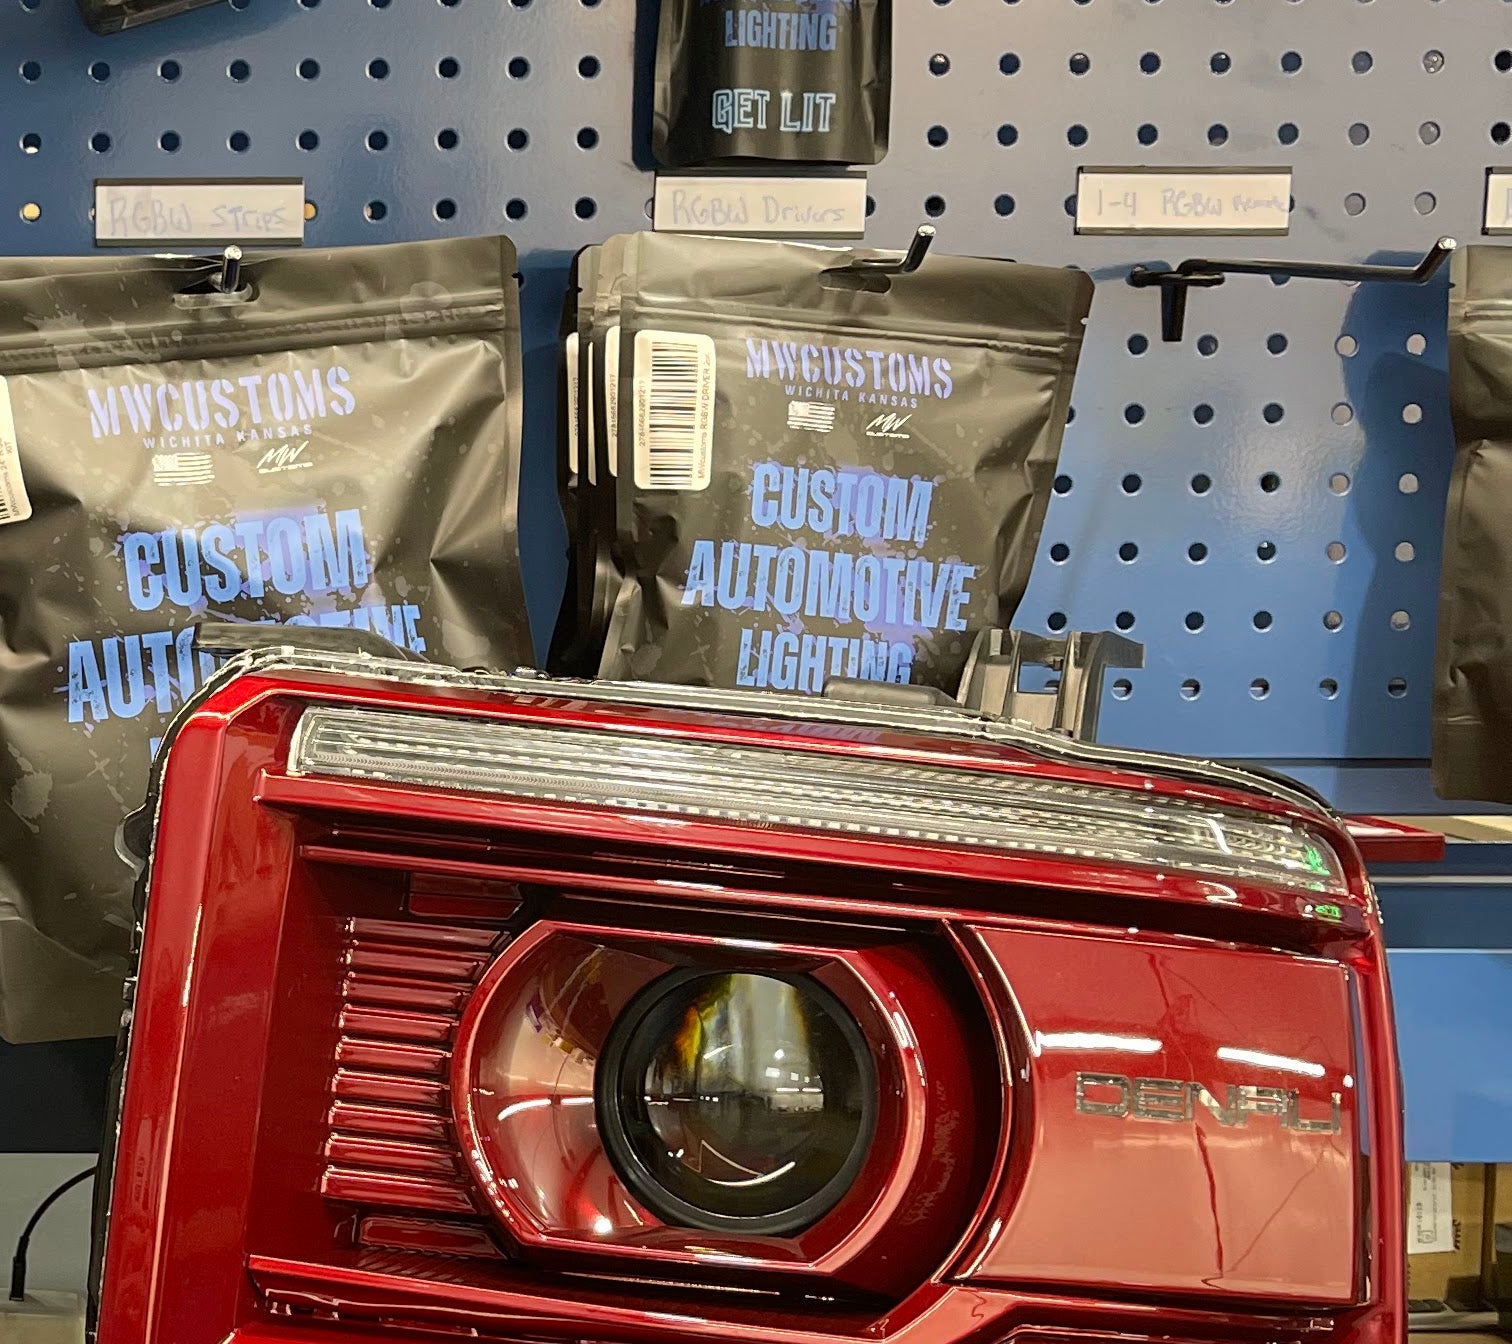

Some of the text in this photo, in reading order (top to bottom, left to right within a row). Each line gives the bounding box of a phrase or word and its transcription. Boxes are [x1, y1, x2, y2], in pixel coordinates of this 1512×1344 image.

[724, 9, 838, 51] LIGHTING
[712, 88, 836, 134] GET LIT
[110, 197, 192, 238] RGBW
[671, 189, 750, 226] RGBW
[745, 337, 953, 399] MWCUSTOMS
[784, 384, 918, 409] WICHITA KANSAS
[87, 365, 356, 439] MWCUSTOMS
[142, 423, 313, 449] WICHITA KANSAS
[751, 462, 934, 543] CUSTOM
[123, 508, 369, 612] CUSTOM
[680, 539, 977, 632] AUTOMOTIVE
[736, 627, 915, 693] LIGHTING
[1075, 1070, 1342, 1135] DENALI
